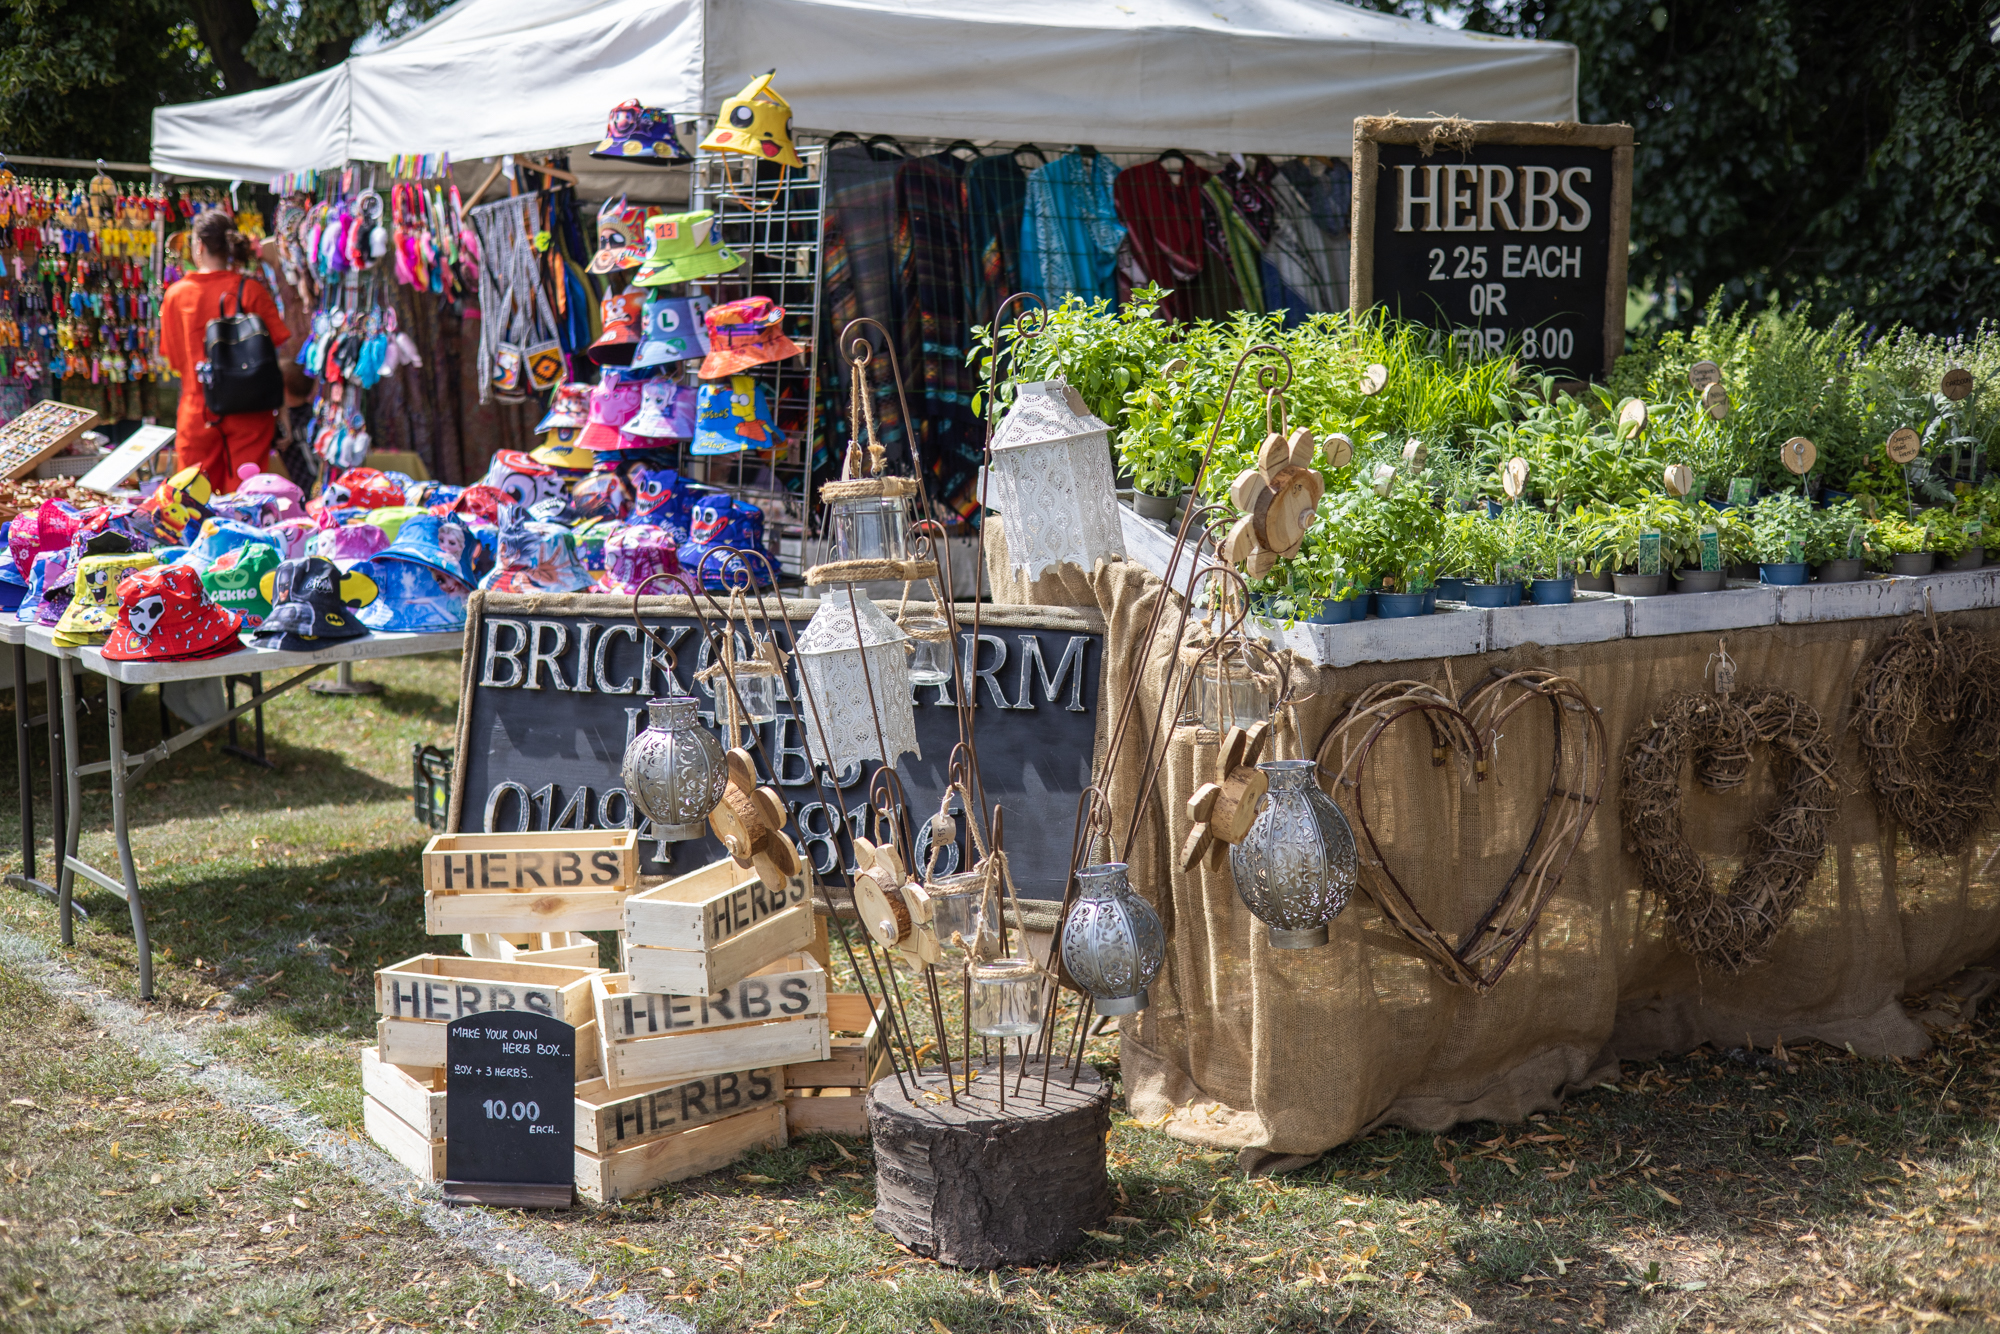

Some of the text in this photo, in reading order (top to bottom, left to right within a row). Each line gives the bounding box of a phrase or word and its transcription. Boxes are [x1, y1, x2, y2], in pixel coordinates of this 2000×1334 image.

[1393, 164, 1592, 233] HERBS
[659, 225, 674, 238] 13
[1428, 245, 1582, 281] 2.25 EACH
[1469, 283, 1508, 316] OR
[661, 313, 674, 328] L
[1452, 327, 1506, 360] FOR
[1521, 327, 1574, 360] 8.00
[210, 587, 258, 602] GEKKO
[935, 827, 949, 845] 3.95
[443, 850, 621, 889] HERBS
[712, 871, 806, 941] HERBS
[392, 979, 554, 1020] HERBS
[623, 977, 811, 1036] HERBS
[452, 1027, 538, 1040] MAKE YOUR OWN
[502, 1043, 531, 1054] HERB
[454, 1064, 472, 1075] BOX
[485, 1066, 493, 1077] 3
[482, 1099, 541, 1122] 10.00
[615, 1068, 773, 1141] HERBS
